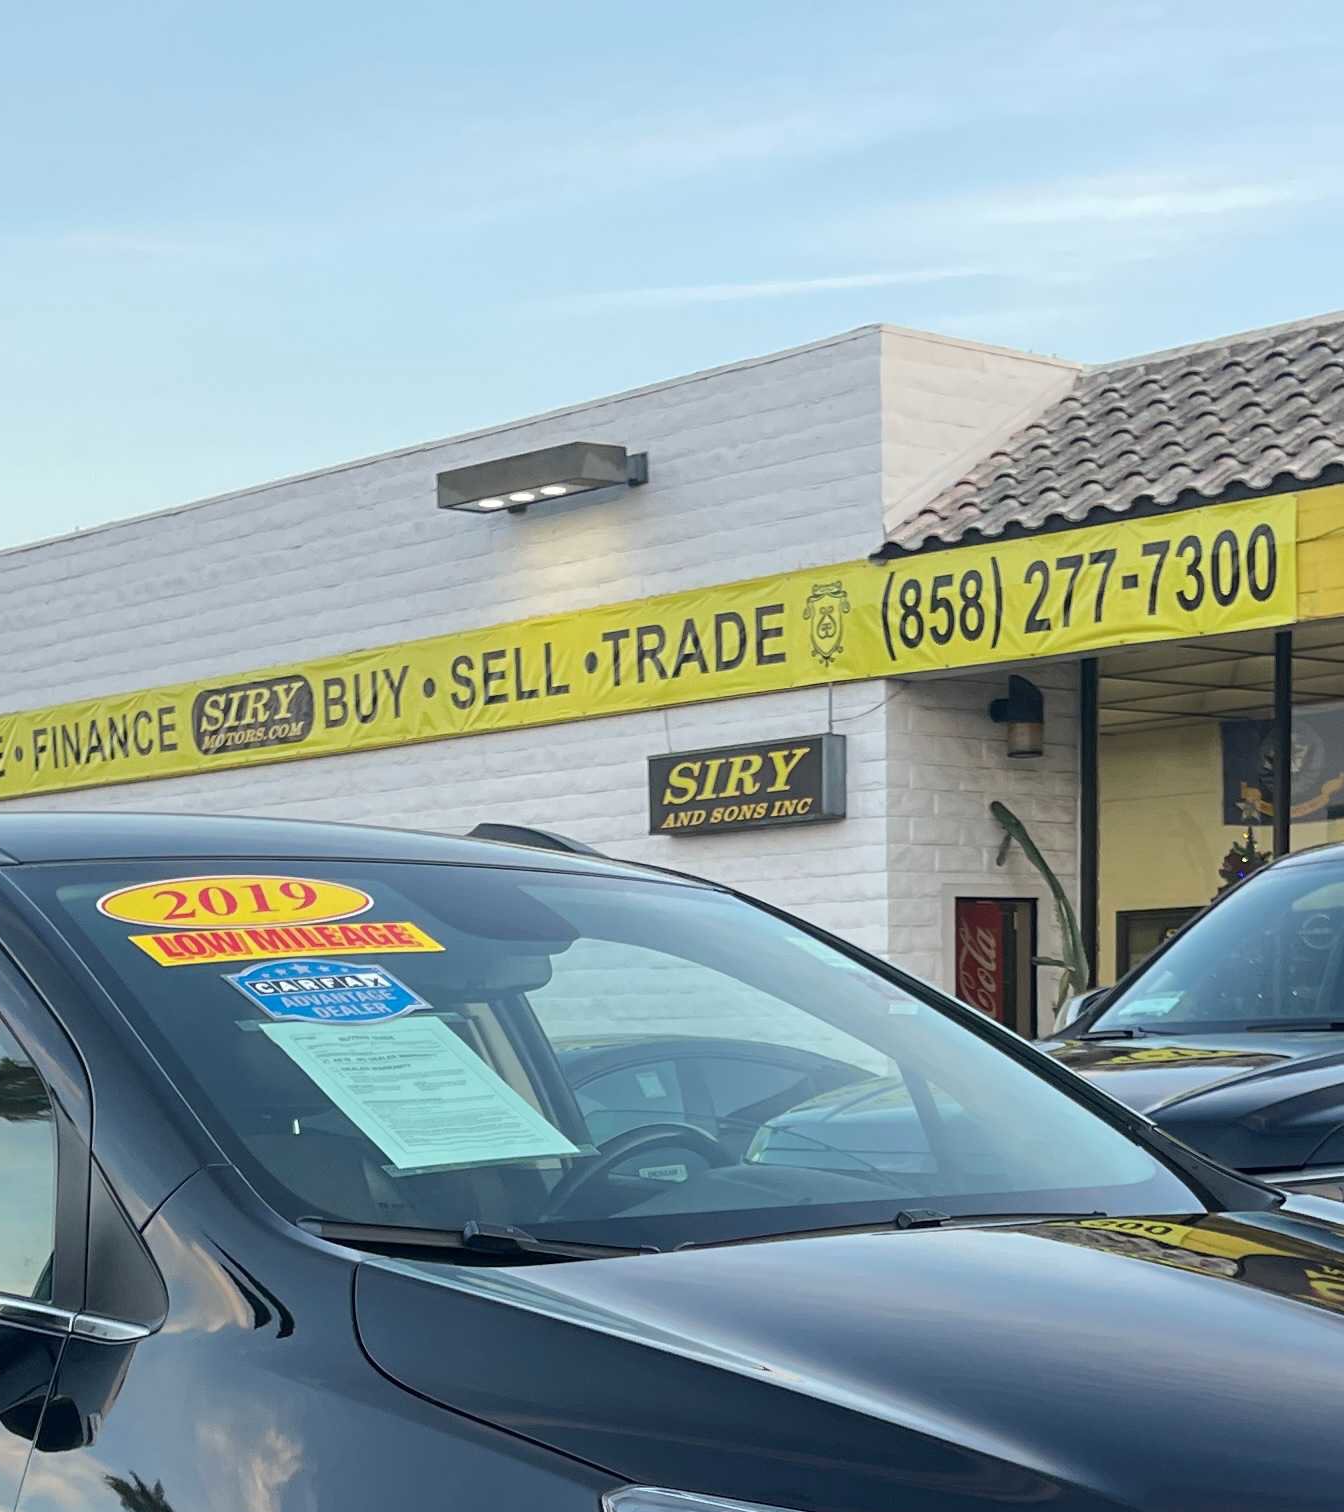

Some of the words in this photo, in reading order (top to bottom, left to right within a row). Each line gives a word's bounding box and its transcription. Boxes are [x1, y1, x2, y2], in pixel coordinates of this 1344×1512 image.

[881, 556, 1003, 661] (858)
[1023, 522, 1277, 635] 277-7300
[322, 665, 411, 729] BUY
[450, 642, 570, 710] SELL
[601, 603, 788, 686] TRADE
[200, 681, 305, 732] SIRY
[34, 706, 179, 771] FINANCE
[201, 721, 305, 750] MOTORS.COM
[663, 747, 811, 805] SIRY
[661, 809, 706, 829] AND
[709, 802, 769, 824] SONS
[770, 798, 814, 817] INC
[152, 881, 318, 921] 2019
[152, 928, 252, 960] LOW
[248, 924, 422, 952] MILEAGE
[253, 972, 392, 995] CARFAX
[280, 988, 397, 1009] ADVANTAGE
[311, 1003, 393, 1019] DEALER
